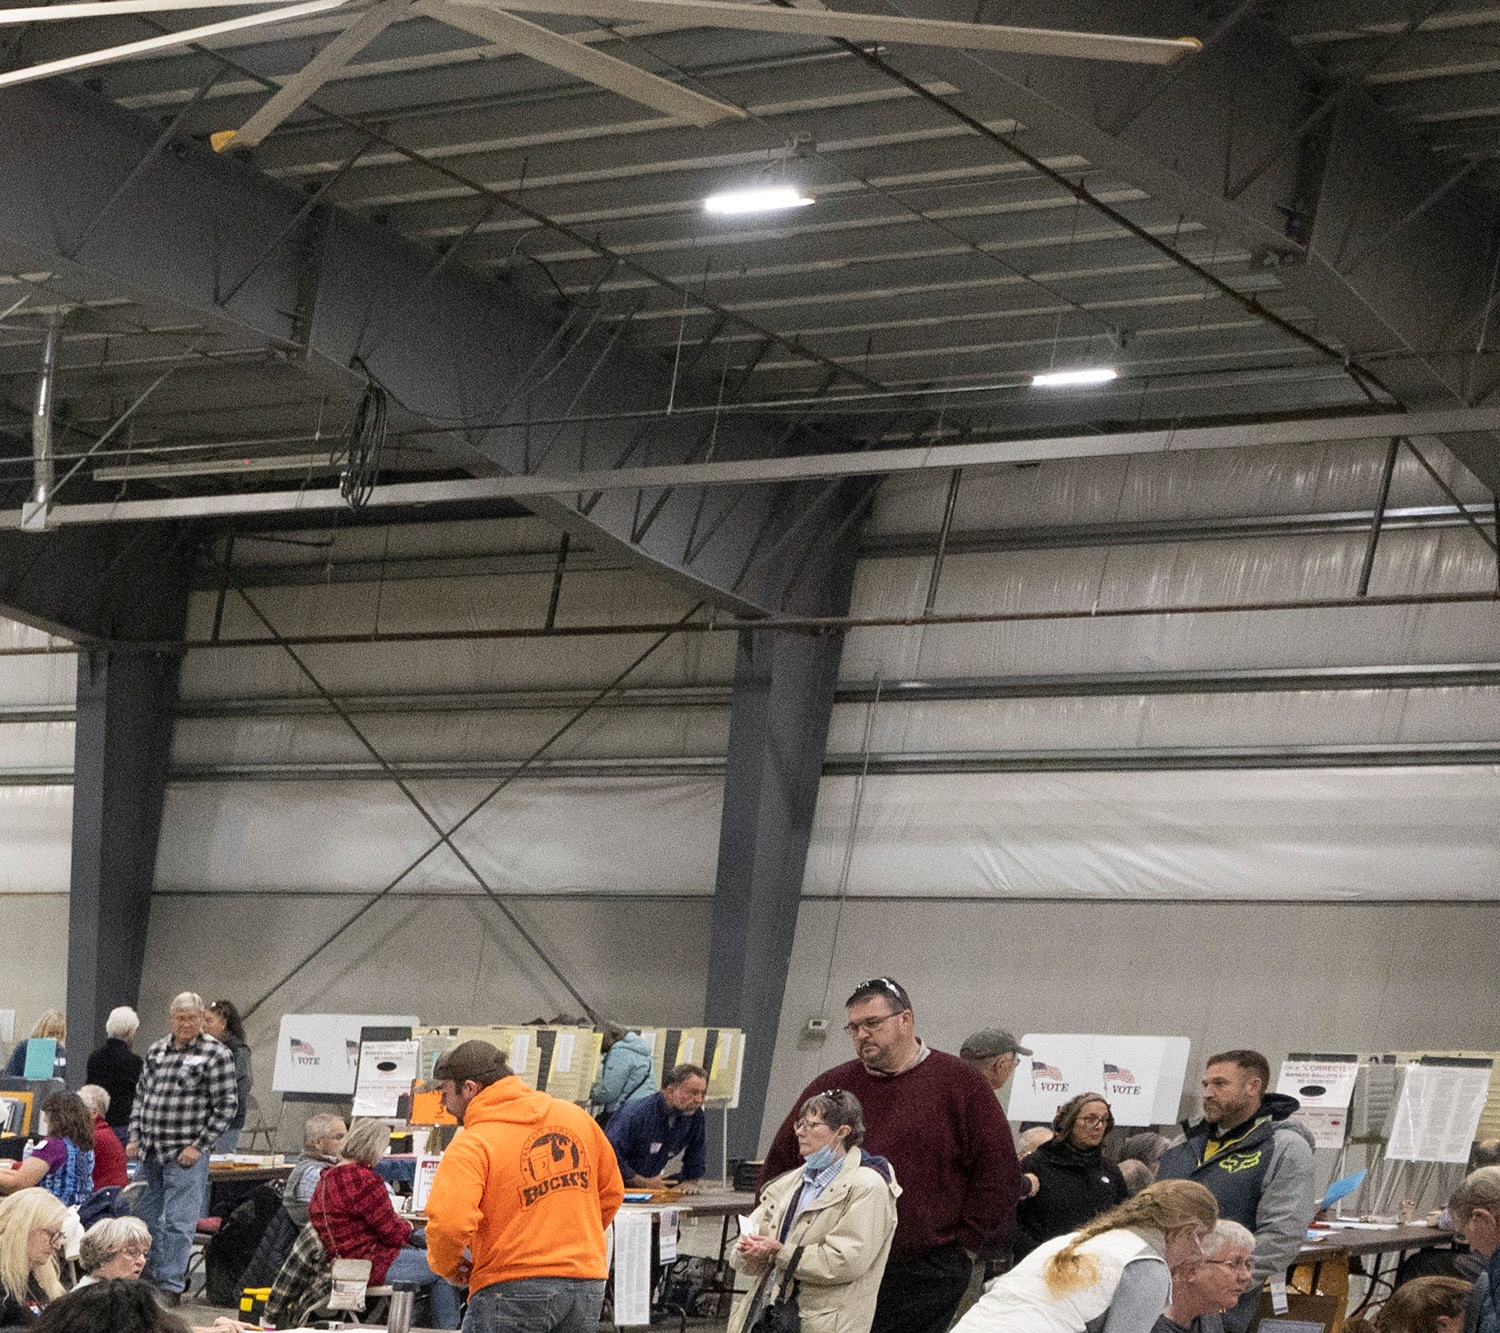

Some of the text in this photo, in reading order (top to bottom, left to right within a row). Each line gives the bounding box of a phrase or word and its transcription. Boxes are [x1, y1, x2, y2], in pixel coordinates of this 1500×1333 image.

[298, 1057, 320, 1065] VOTE
[1041, 1082, 1069, 1092] VOTE
[1112, 1085, 1141, 1095] VOTE
[523, 1171, 589, 1207] BUCK'S
